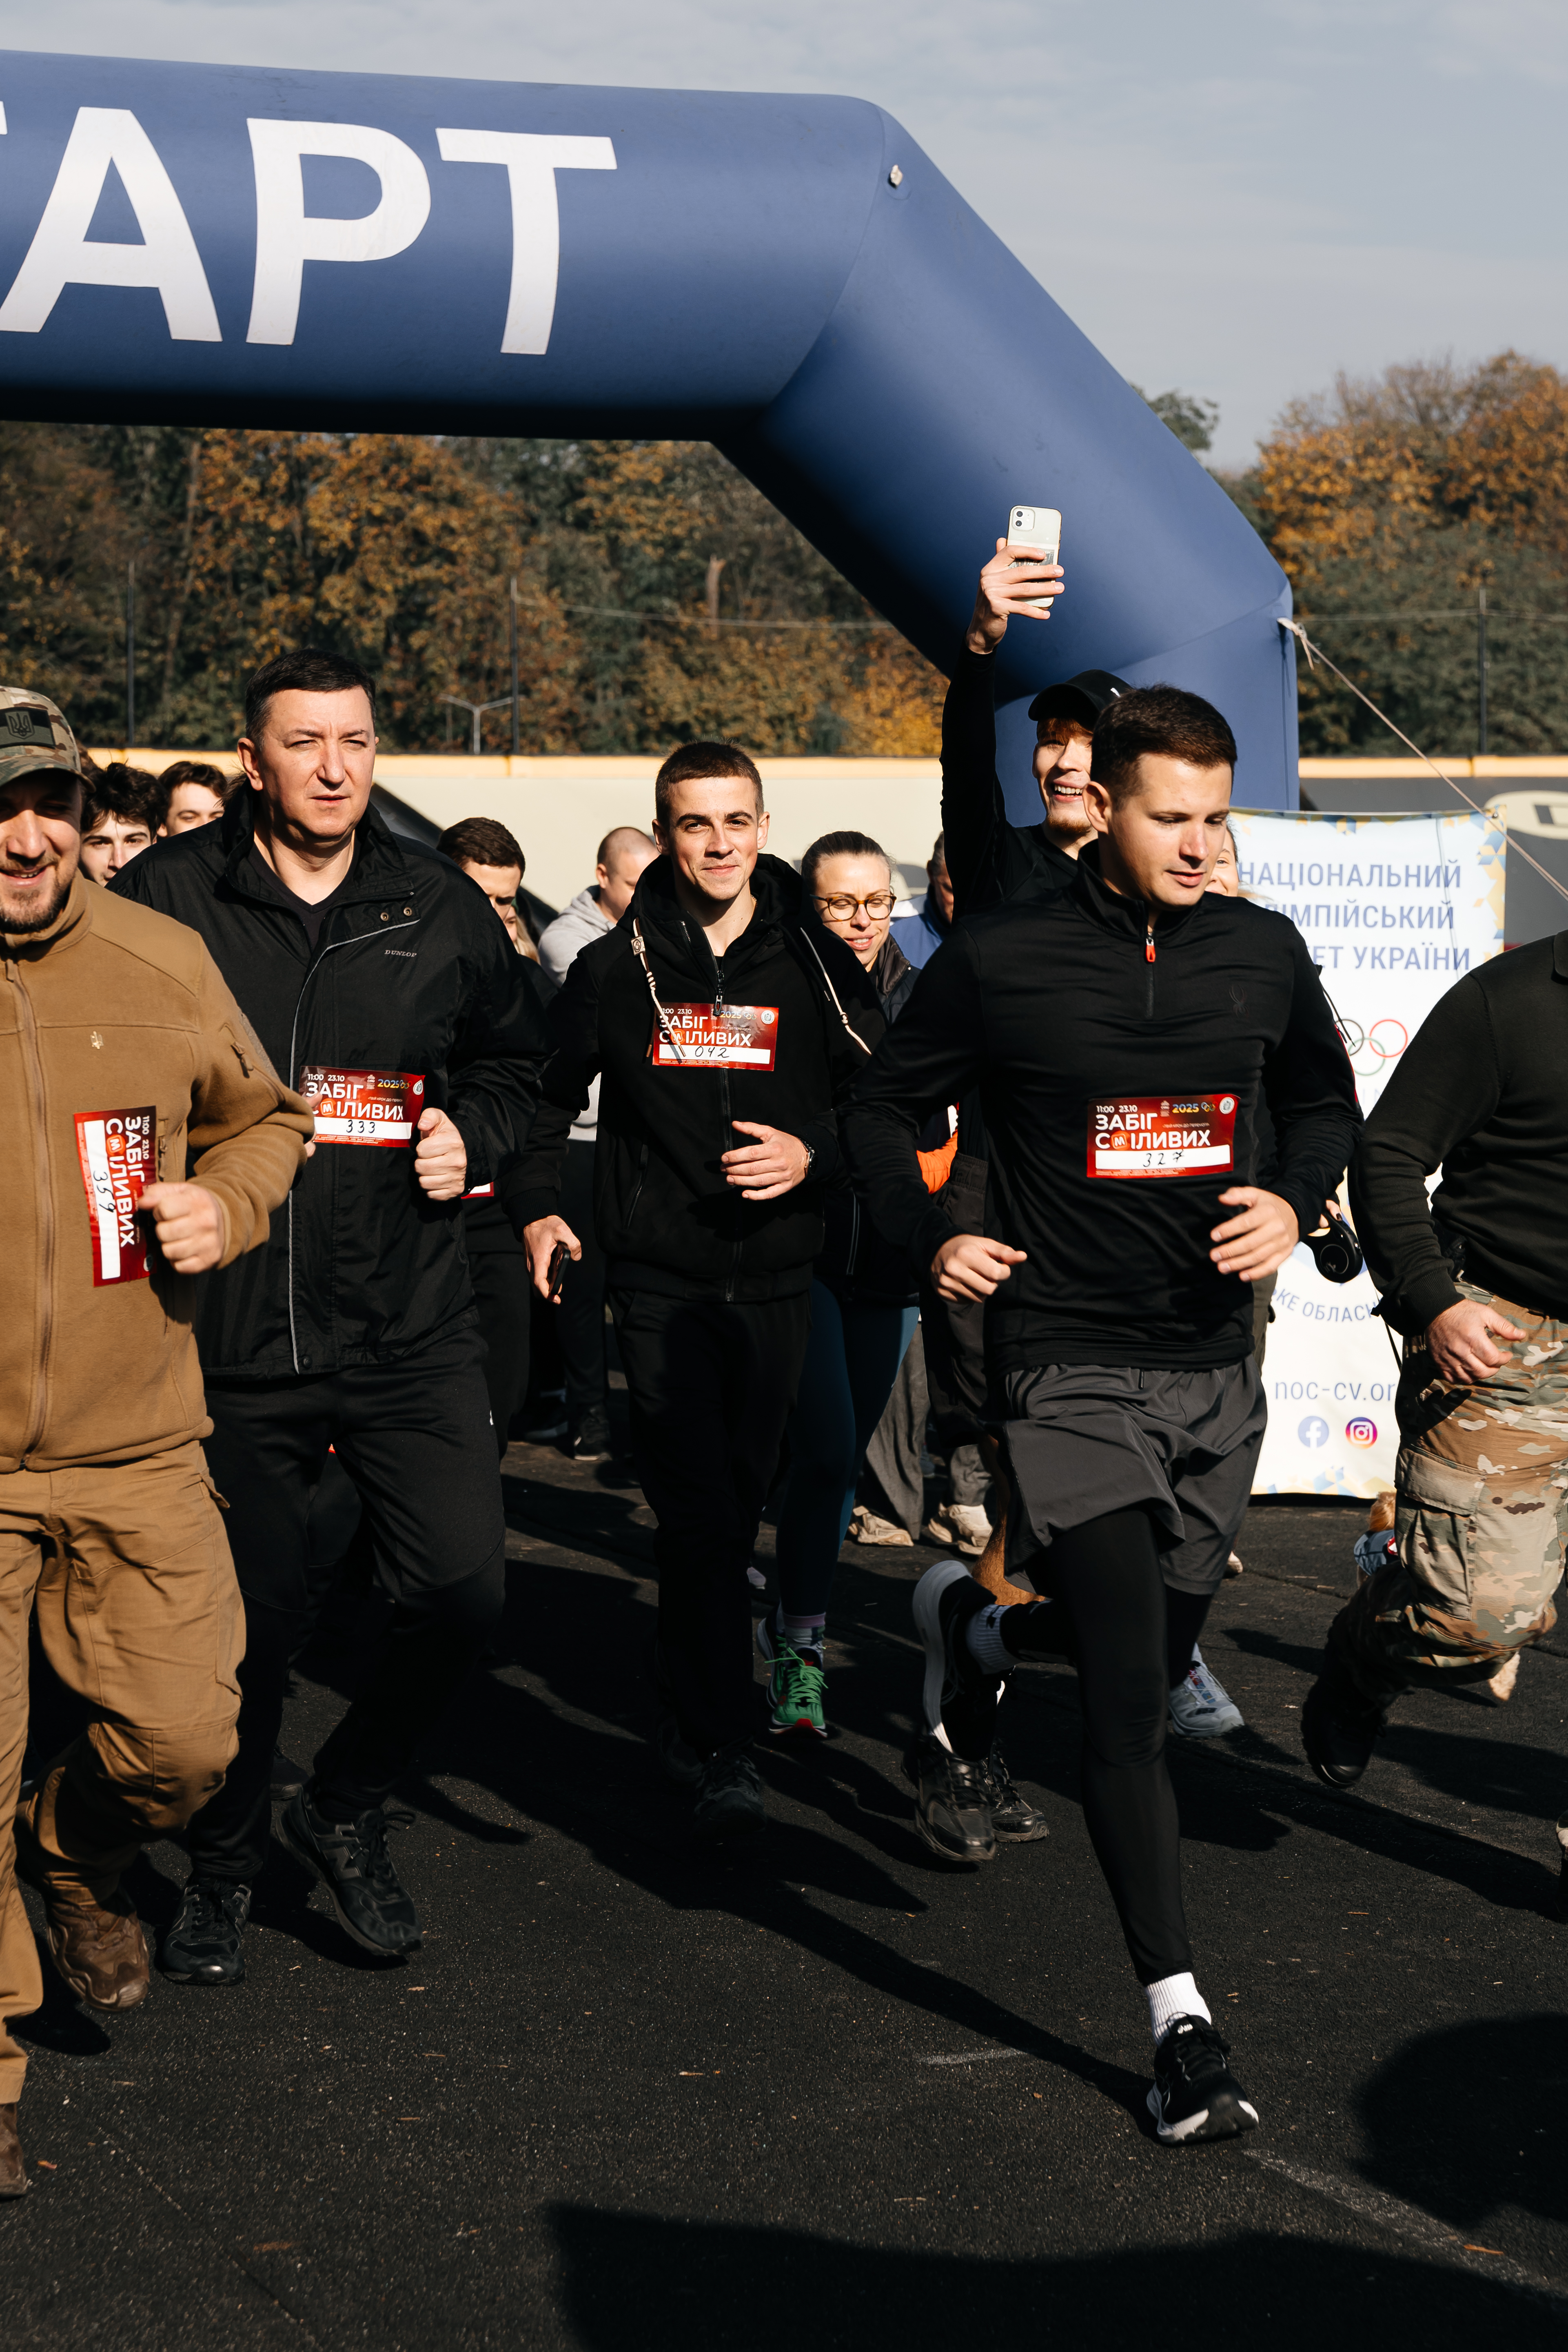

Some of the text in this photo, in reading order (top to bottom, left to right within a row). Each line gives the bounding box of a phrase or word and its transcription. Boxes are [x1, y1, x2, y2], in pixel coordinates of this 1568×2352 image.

[0, 102, 617, 355] АРТ
[1239, 860, 1460, 890] НАЦІОНАЛЬНИЙ
[1353, 942, 1469, 970] УКРАЇНИ
[659, 1015, 708, 1029] ЗАБІГ
[695, 1046, 730, 1058] 042
[306, 1082, 364, 1100] ЗАБІГ
[377, 1079, 399, 1088] 2025
[1172, 1103, 1199, 1113] 2025
[346, 1119, 375, 1133] 333
[1096, 1113, 1158, 1131] ЗАБІГ
[125, 1116, 145, 1182] ЗАБІГ
[1143, 1149, 1184, 1167] 327
[1275, 1382, 1395, 1401] noc-cv.or
